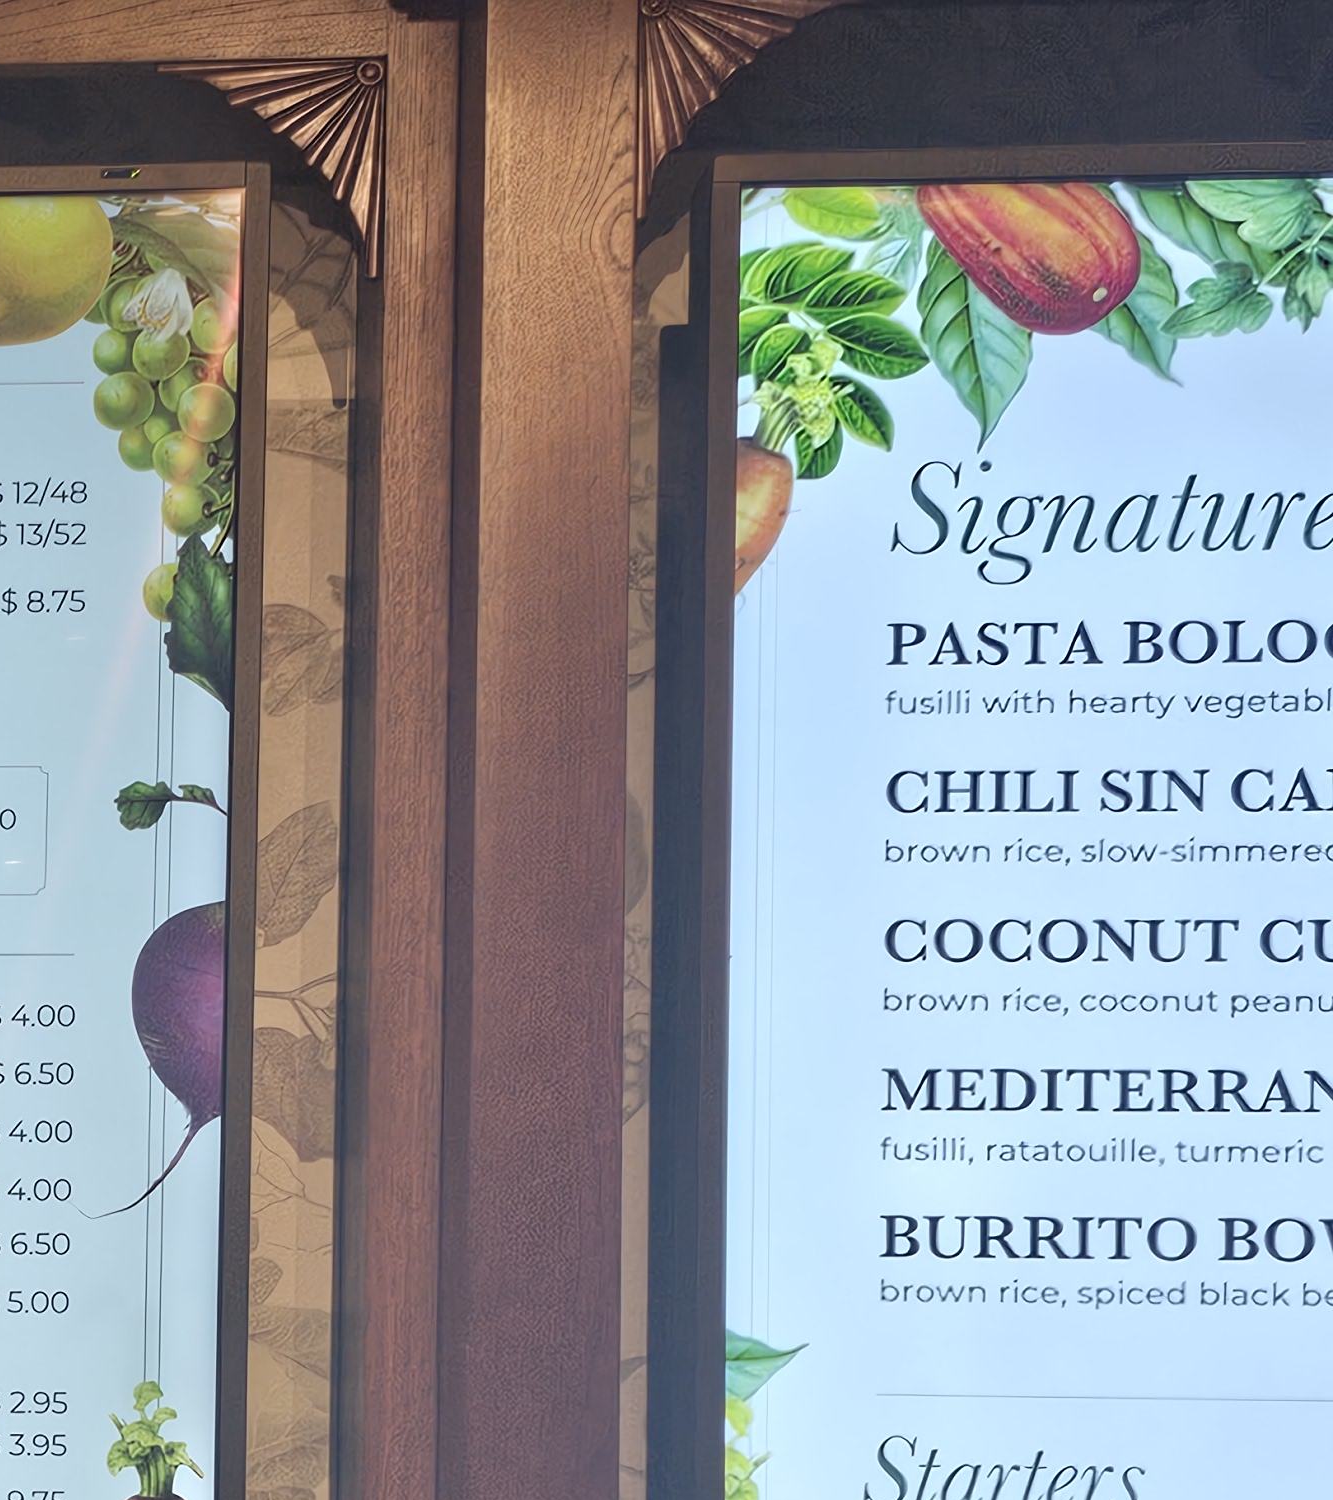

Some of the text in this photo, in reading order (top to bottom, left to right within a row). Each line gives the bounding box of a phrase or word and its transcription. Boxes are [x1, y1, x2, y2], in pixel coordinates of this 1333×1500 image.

[885, 619, 1104, 666] PASTA
[885, 688, 971, 715] fusilli
[981, 688, 1055, 714] with
[1068, 687, 1176, 720] hearty
[886, 767, 1211, 814] CHILI SIN
[884, 917, 1240, 964] COCONUT
[883, 986, 989, 1012] brown
[1002, 985, 1069, 1017] rice,
[1079, 989, 1218, 1013] coconut
[880, 1135, 1324, 1166] fusilli, ratatouille, turmeric
[879, 1213, 1198, 1262] BURRITO
[880, 1277, 1290, 1310] brown rice, spiced black
